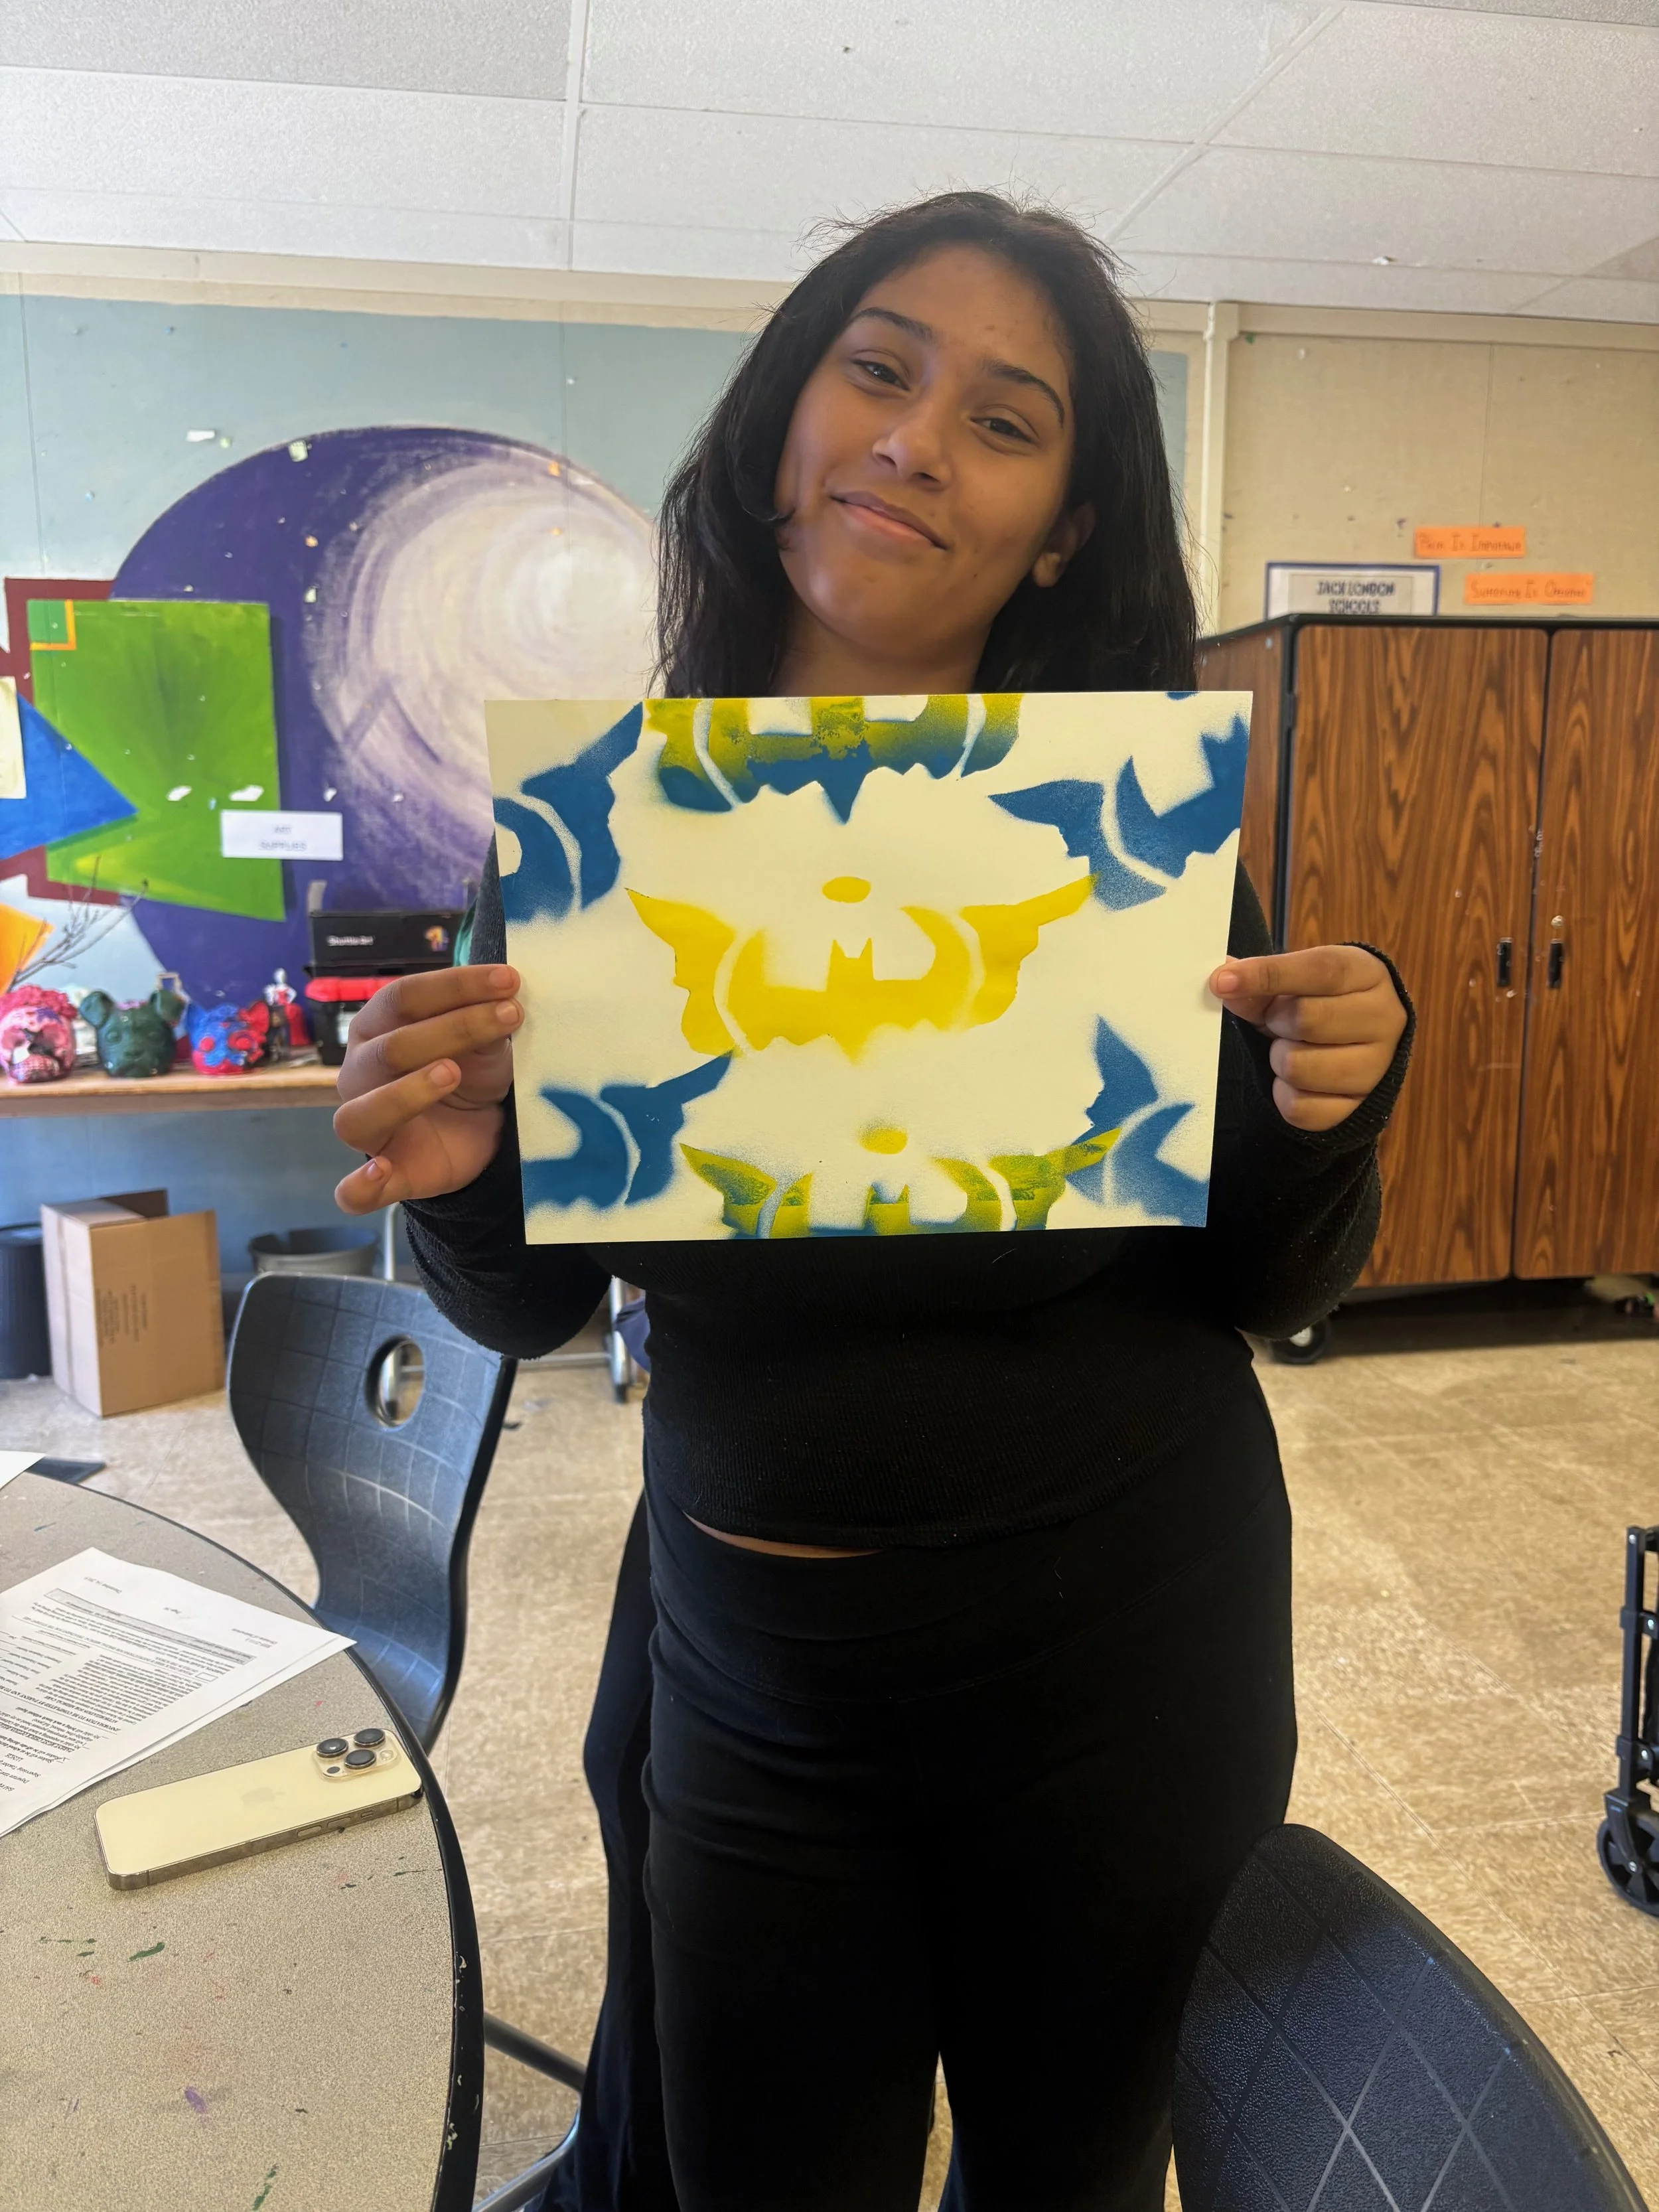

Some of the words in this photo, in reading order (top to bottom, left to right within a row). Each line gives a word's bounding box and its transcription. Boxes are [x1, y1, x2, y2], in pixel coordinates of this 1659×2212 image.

[1317, 580, 1346, 595] JACK
[1348, 580, 1395, 596] LONDON
[1329, 598, 1380, 614] SCHOOLS
